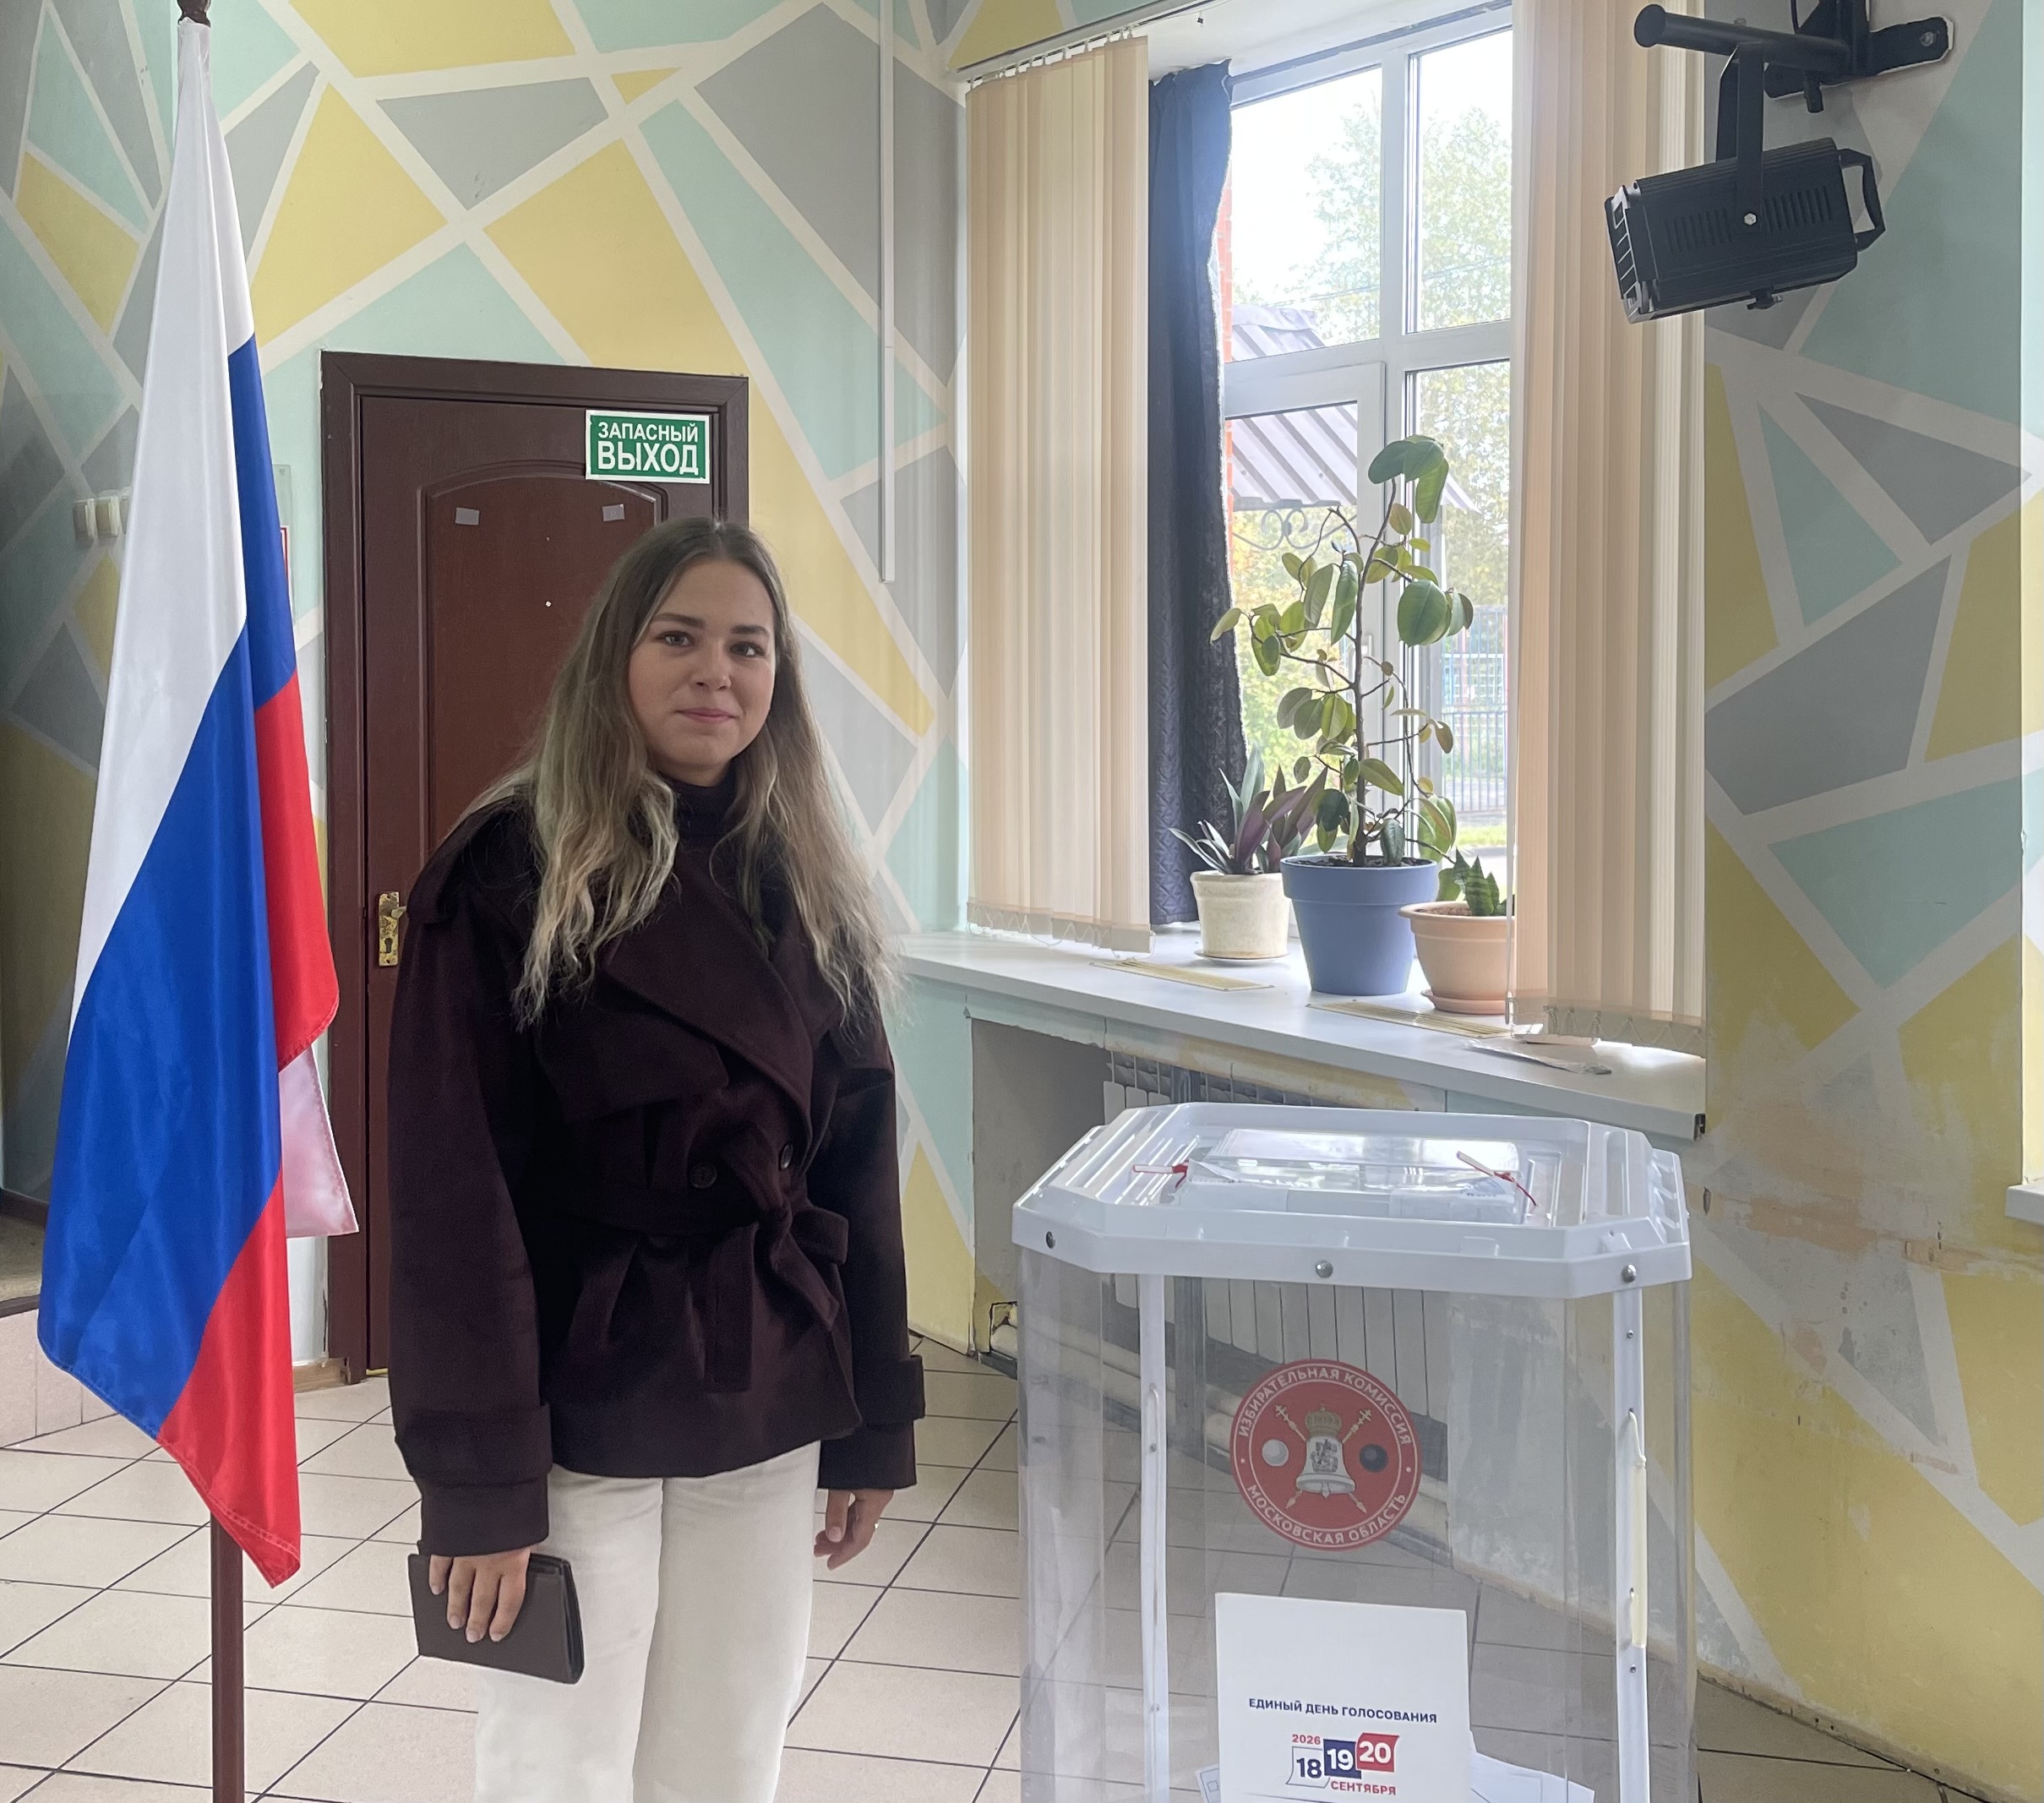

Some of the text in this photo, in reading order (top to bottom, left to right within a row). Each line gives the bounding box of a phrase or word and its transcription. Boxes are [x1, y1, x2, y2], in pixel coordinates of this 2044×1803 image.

[597, 422, 699, 443] ЗАПАСНЫЙ
[597, 440, 699, 476] ВЫХОД
[1239, 1367, 1412, 1445] ИЗБИРАТЕЛЬНАЯ КОМИССИЯ
[1246, 1484, 1406, 1544] МОСКОВСКАЯ ОБЛАСТЬ
[1249, 1697, 1437, 1723] ЕДИНЫЙ ДЕНЬ ГОЛОСОВАНИЯ
[1292, 1734, 1321, 1745] 2026
[1296, 1740, 1391, 1778] 18 19 20
[1330, 1780, 1396, 1795] СЕНТЯБРЯ
